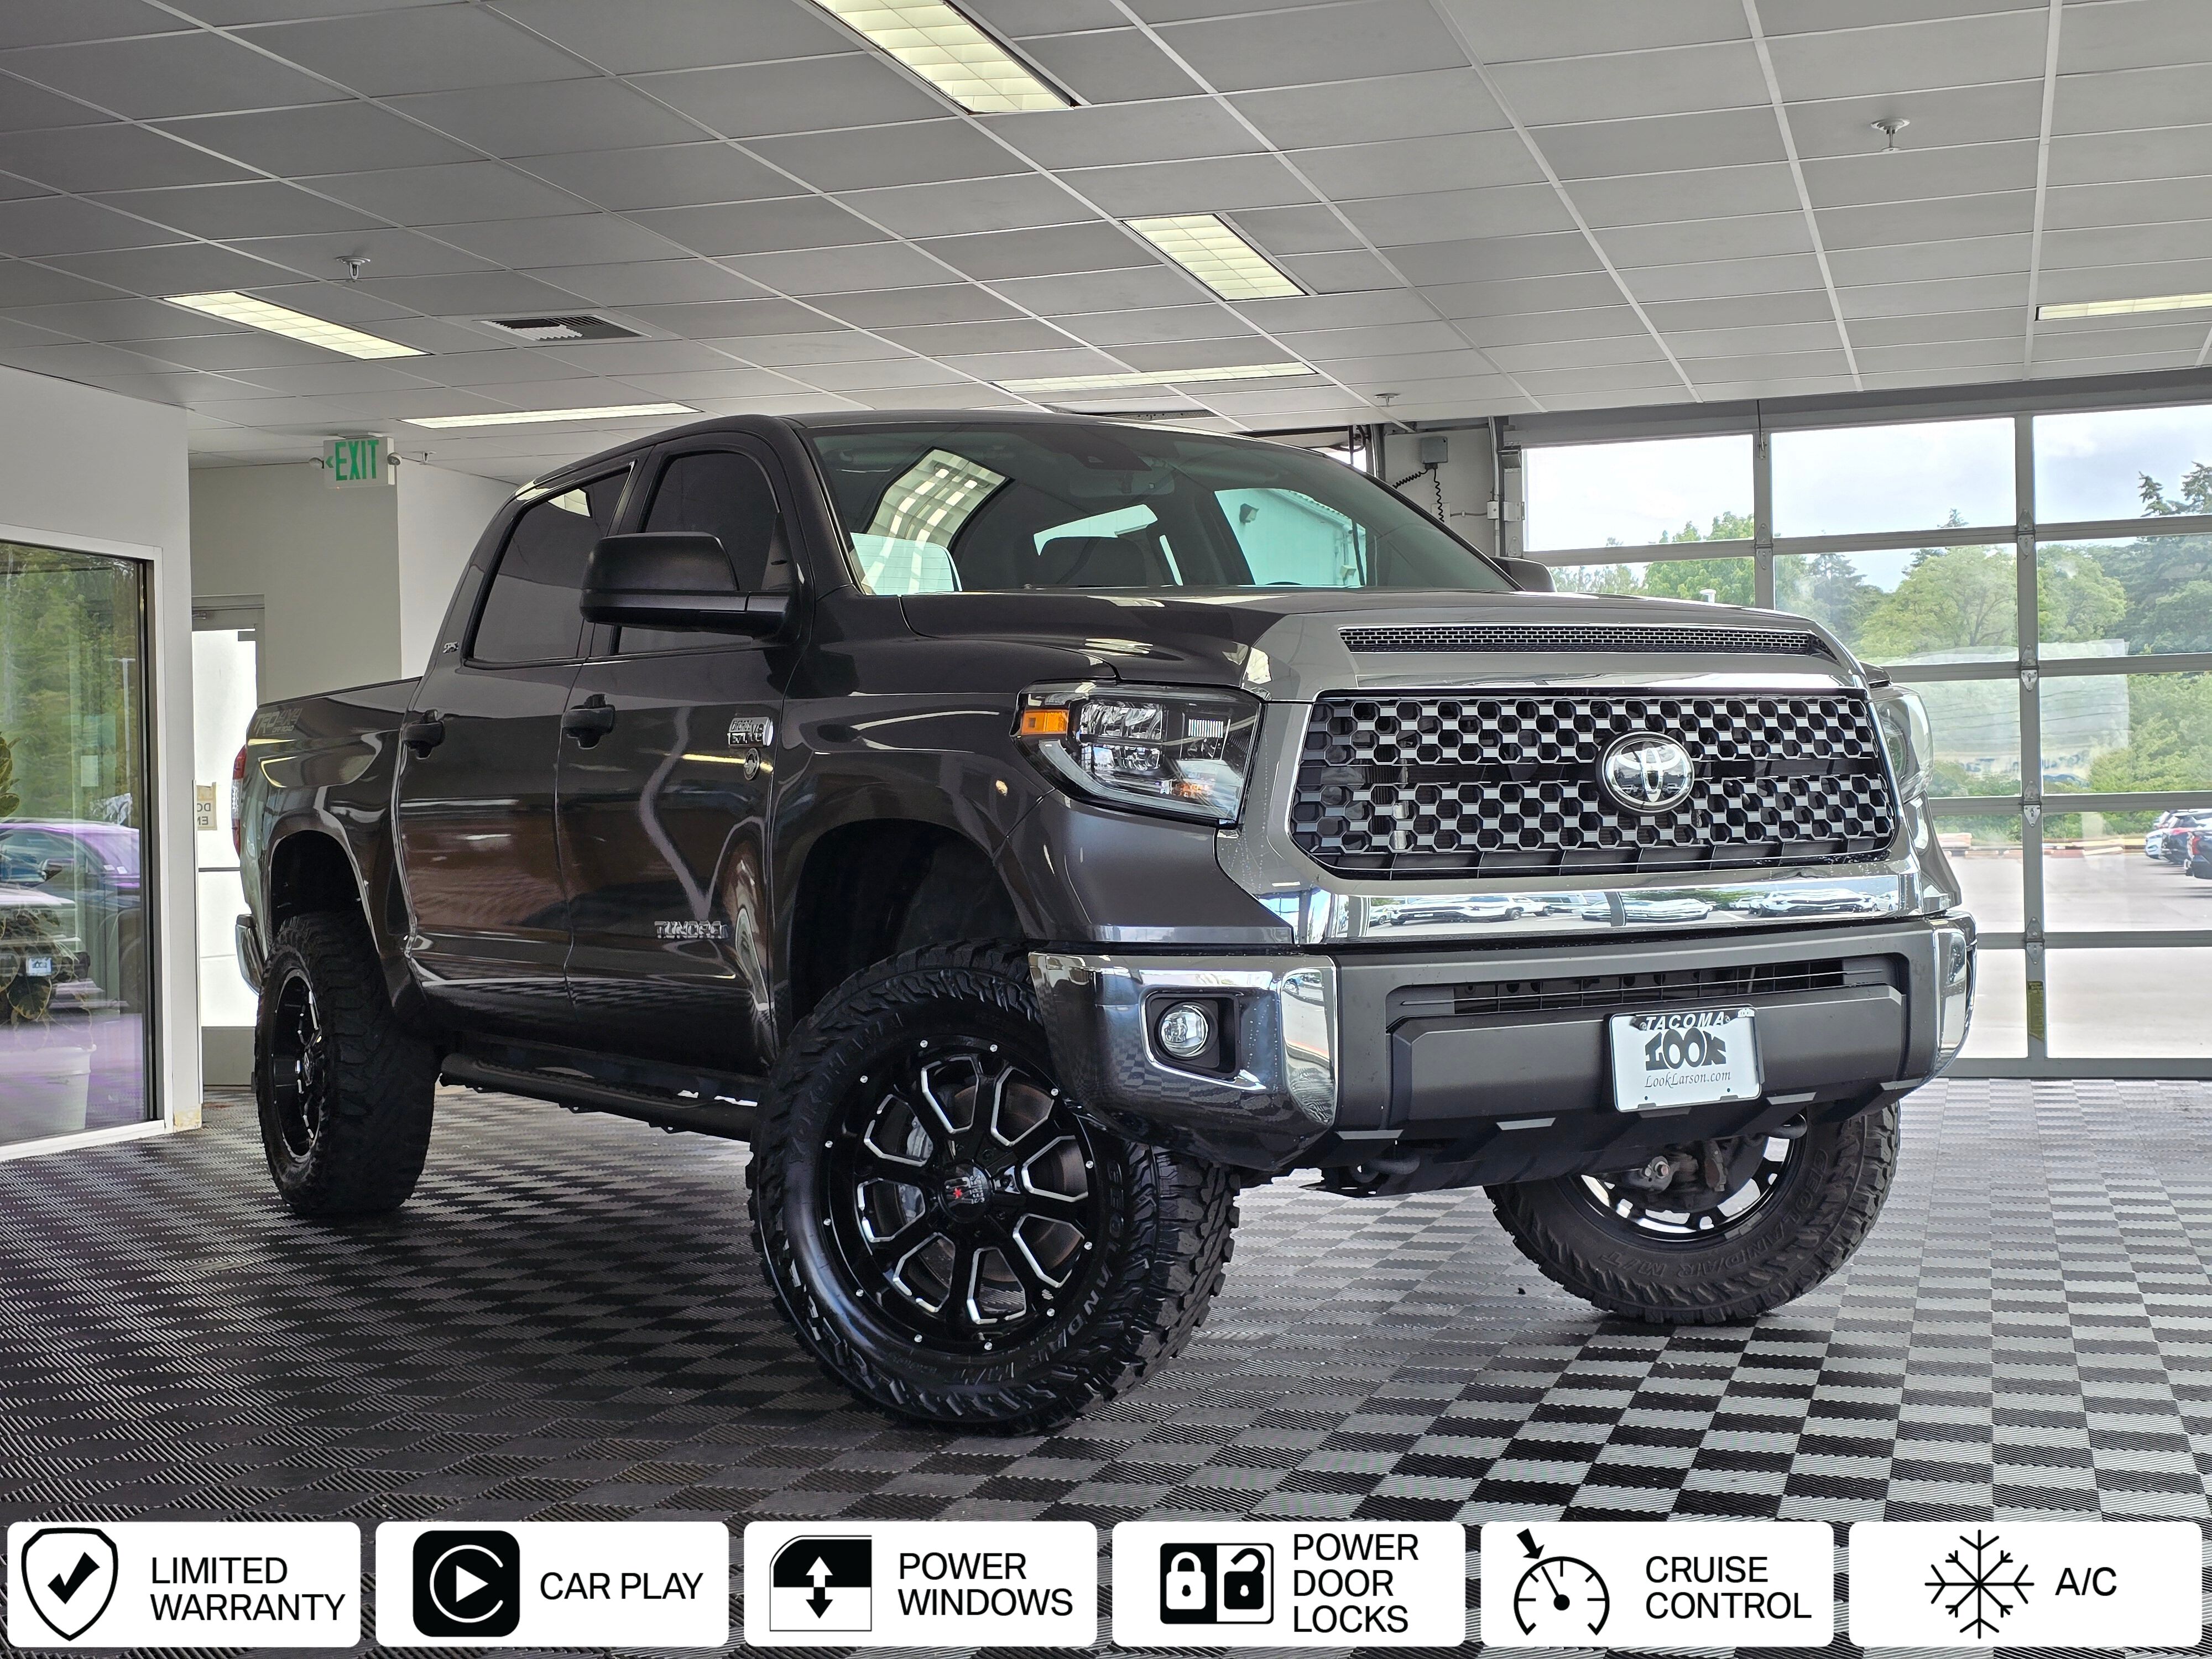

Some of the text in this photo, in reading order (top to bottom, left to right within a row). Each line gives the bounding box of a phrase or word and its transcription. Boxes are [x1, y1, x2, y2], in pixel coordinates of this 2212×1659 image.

[335, 439, 379, 481] EXIT
[654, 920, 722, 939] TUNDRA
[1645, 1011, 1725, 1031] TACOMA
[1645, 1027, 1726, 1071] LOOK
[1644, 1071, 1731, 1089] LookLarson.com
